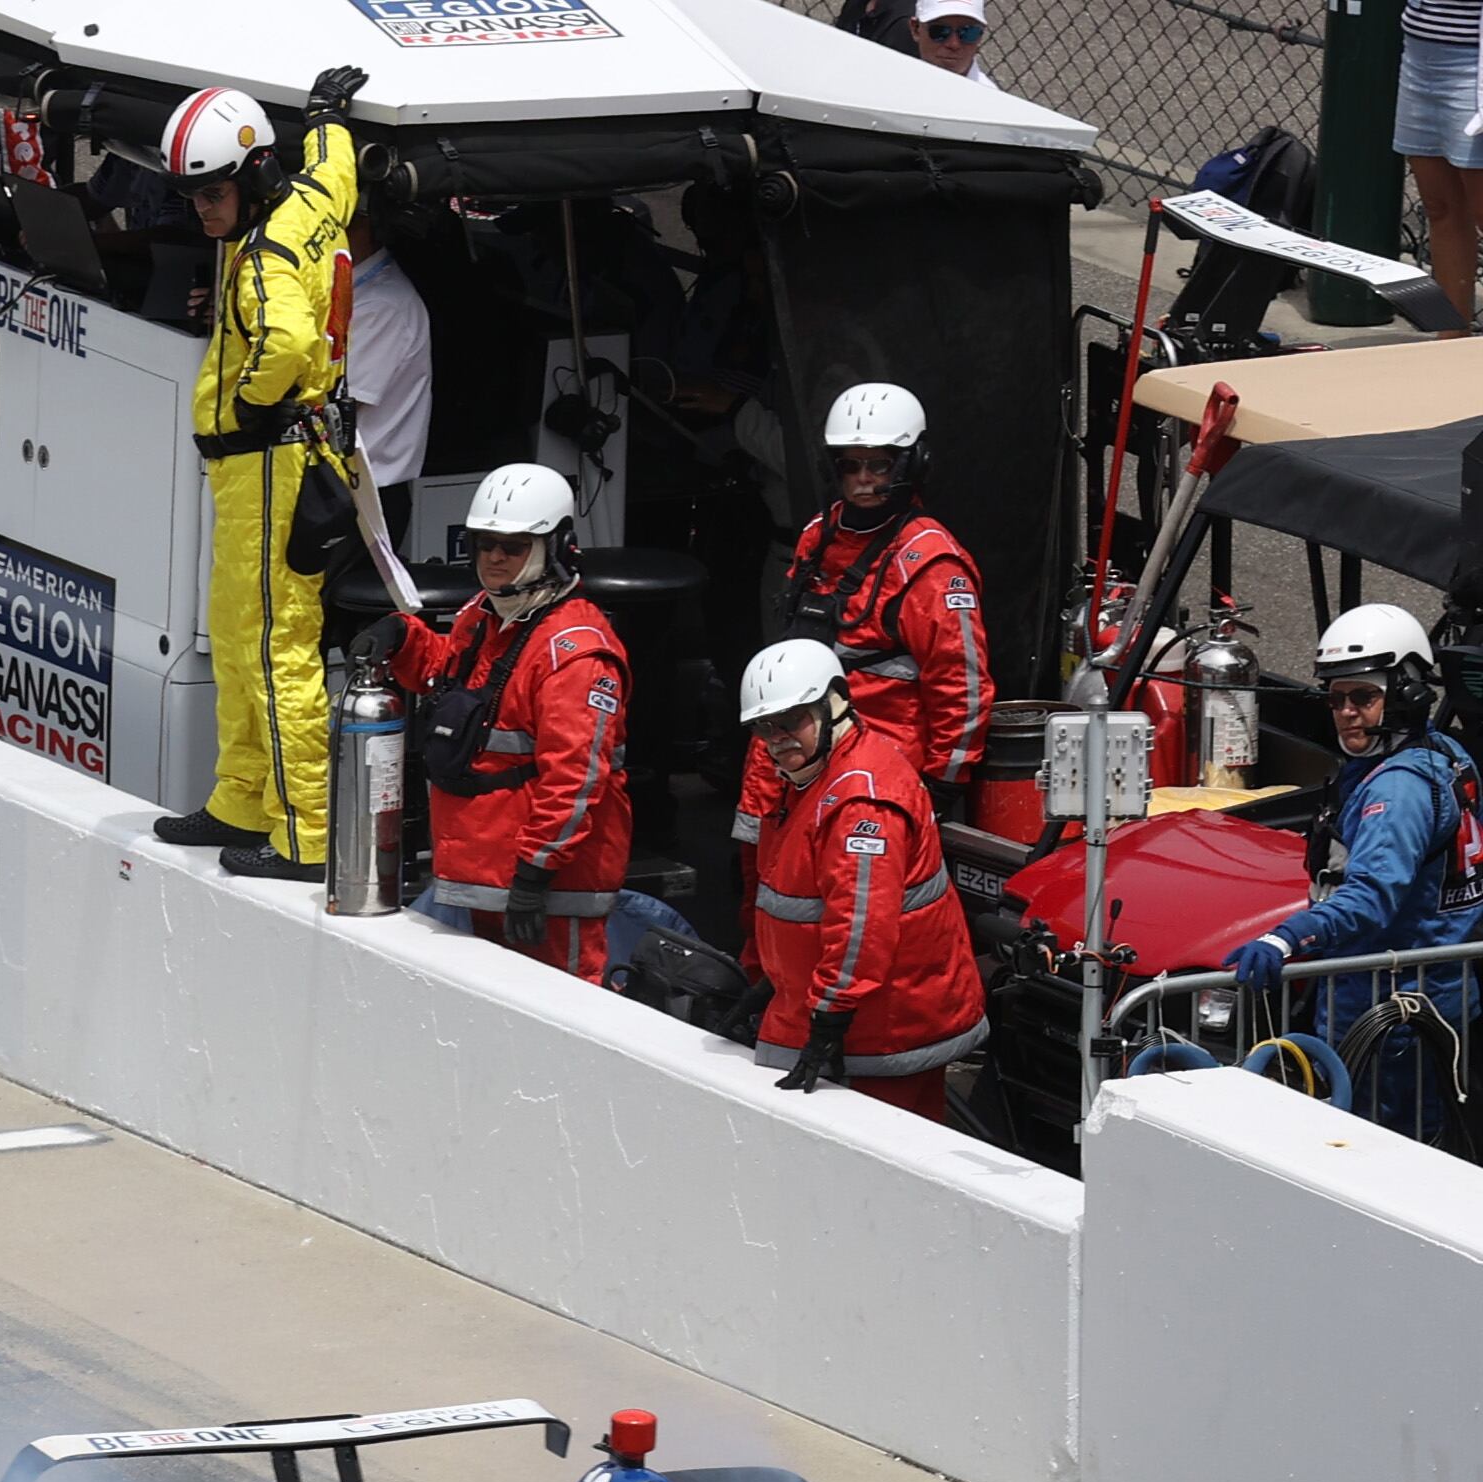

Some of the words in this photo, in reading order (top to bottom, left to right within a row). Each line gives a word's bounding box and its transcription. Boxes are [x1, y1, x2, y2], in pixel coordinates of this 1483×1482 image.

[400, 27, 611, 44] RACING
[426, 13, 597, 34] GANASSI
[1265, 240, 1373, 274] LEGION
[24, 293, 48, 334] THE
[48, 294, 89, 359] ONE
[4, 556, 103, 614] AMERICAN
[341, 1409, 516, 1434] LEGION
[87, 1435, 139, 1452] BE
[146, 1432, 190, 1446] THE
[195, 1427, 278, 1443] ONE
